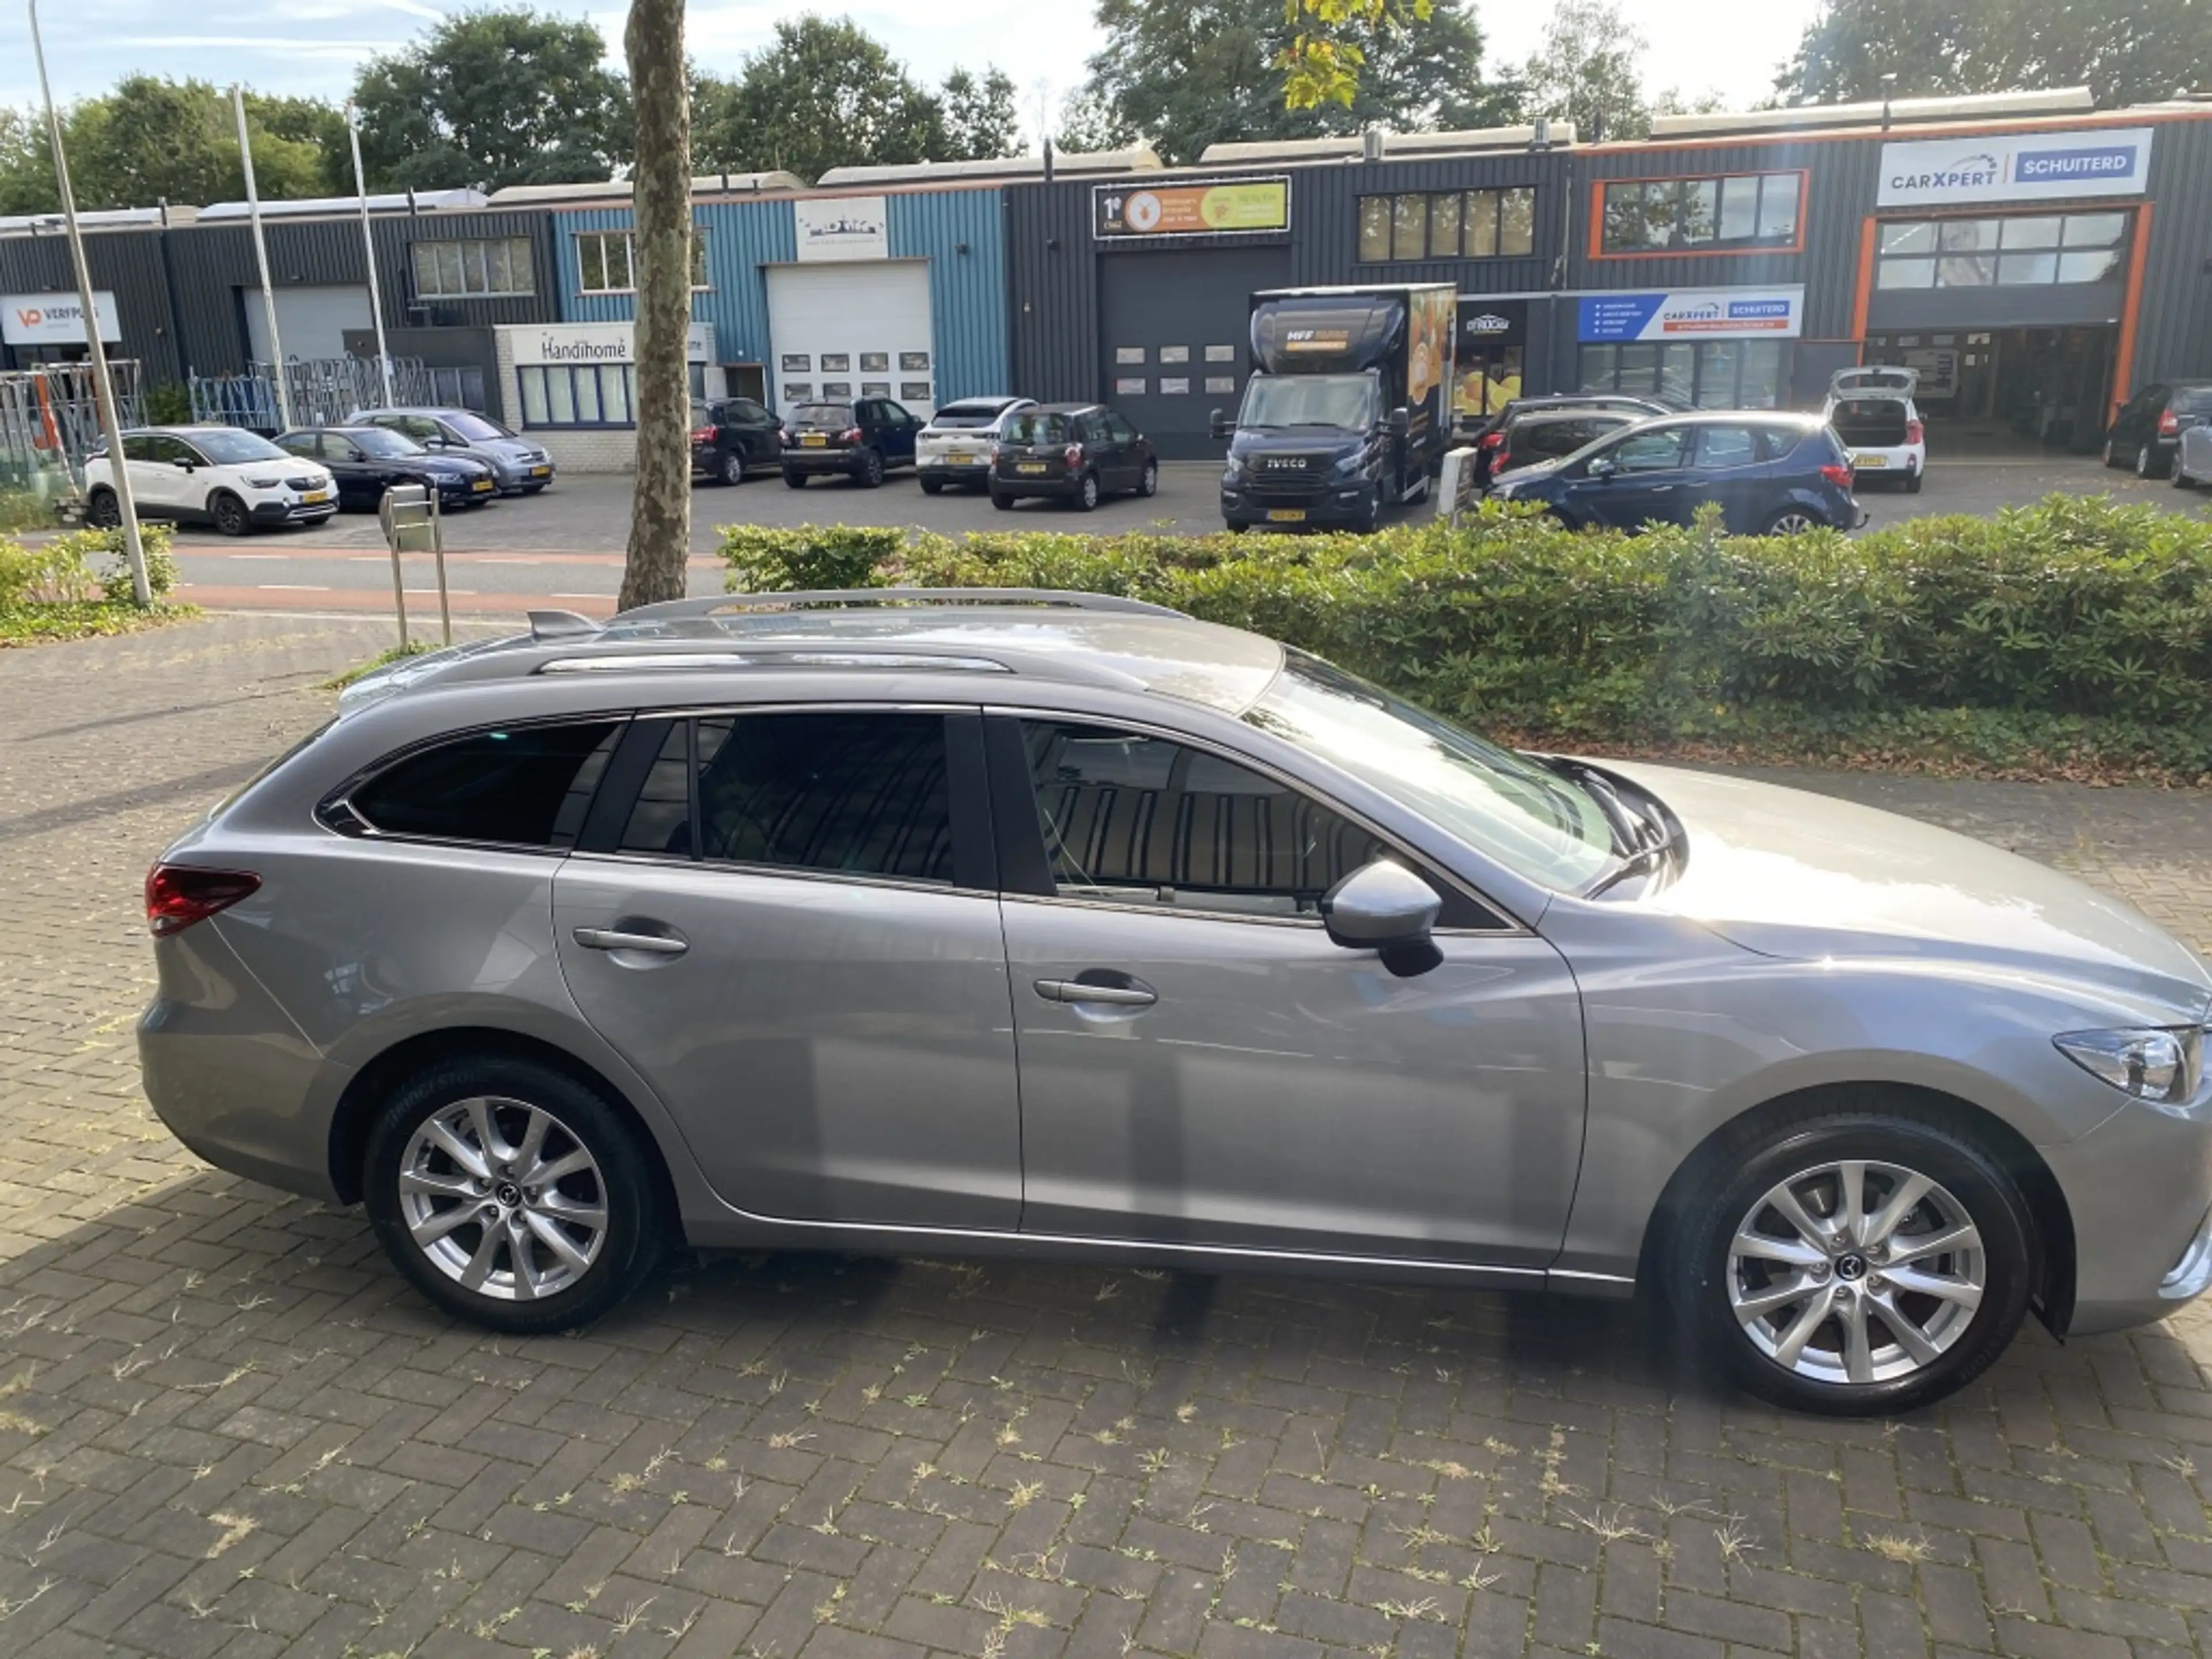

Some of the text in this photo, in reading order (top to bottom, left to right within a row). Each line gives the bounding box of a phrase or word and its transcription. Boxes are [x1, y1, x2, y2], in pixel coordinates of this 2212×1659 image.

[1892, 154, 2127, 190] CARXPERT SCHUITERD
[1267, 458, 1308, 468] IVECO
